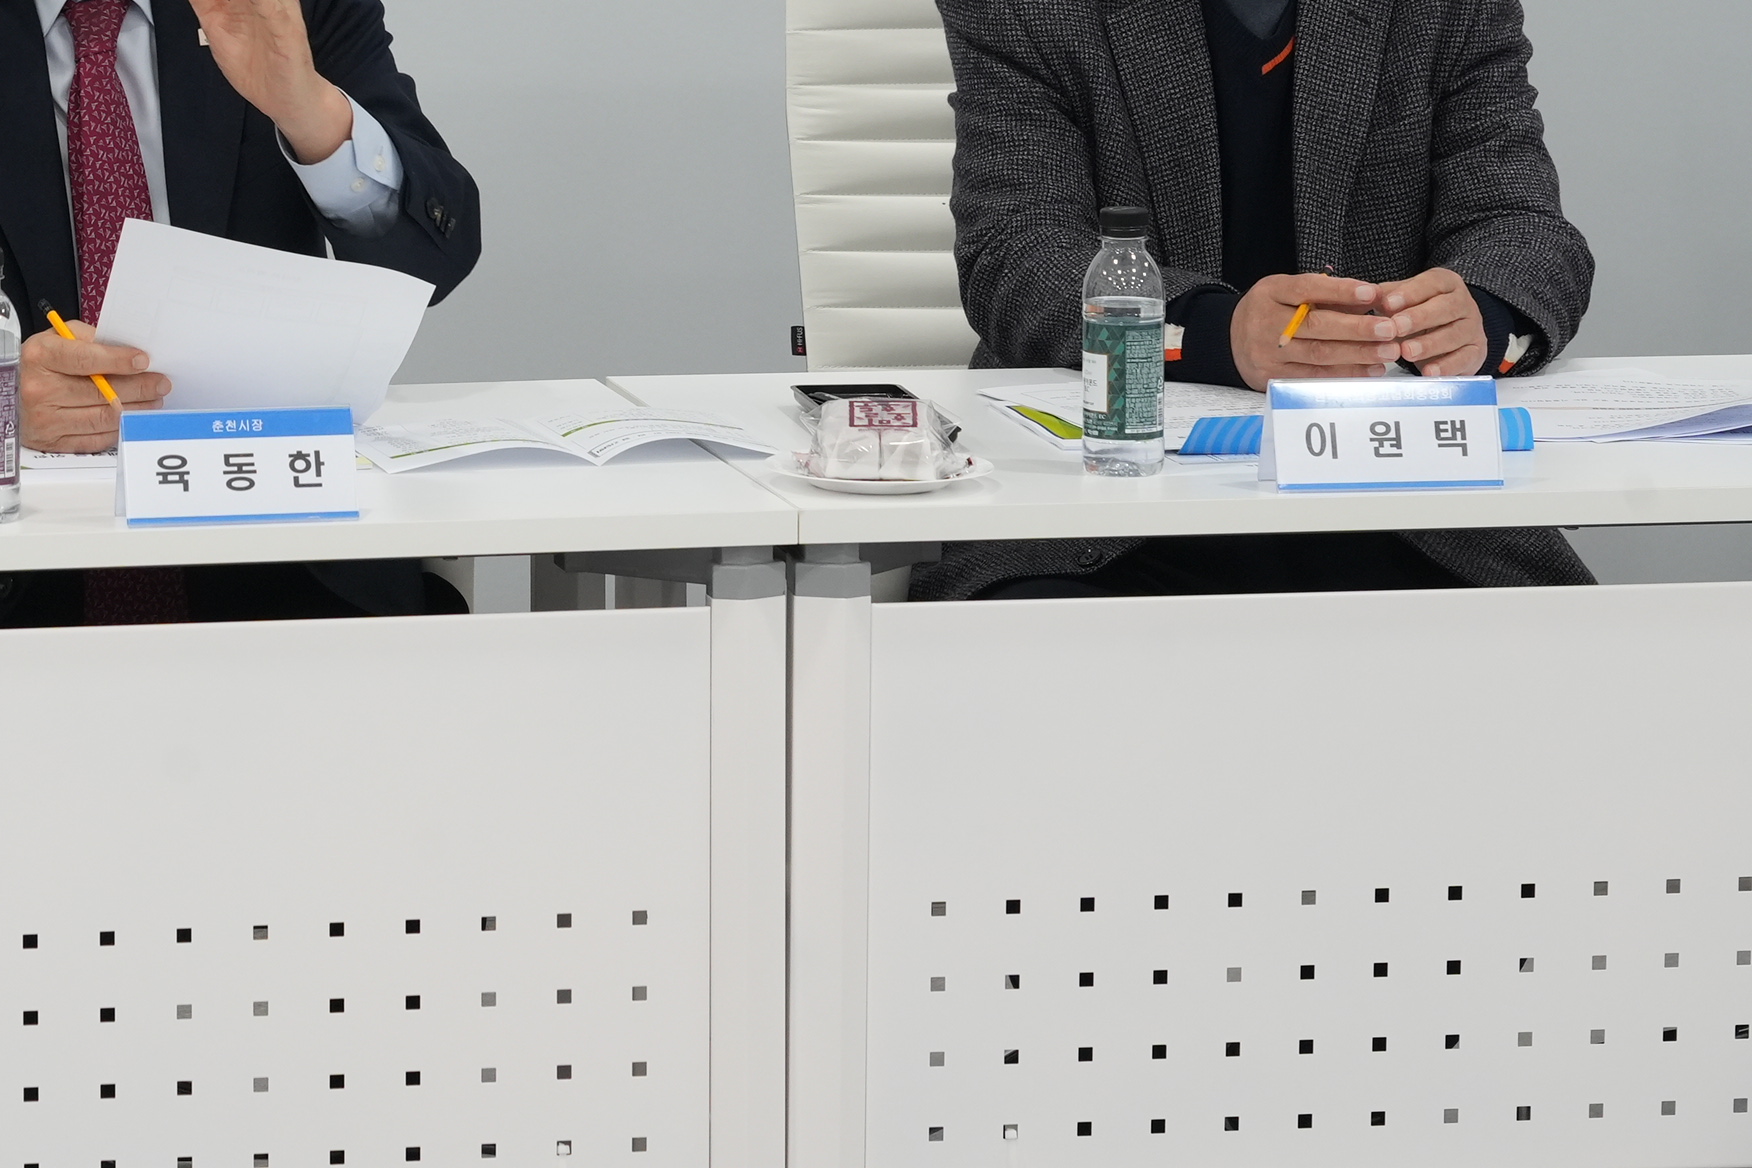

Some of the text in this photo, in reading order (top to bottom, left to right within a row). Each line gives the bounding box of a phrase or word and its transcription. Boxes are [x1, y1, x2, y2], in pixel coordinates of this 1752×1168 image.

[212, 418, 263, 433] 춘천시장
[1305, 418, 1469, 460] 이원택
[155, 449, 326, 492] 육동한
